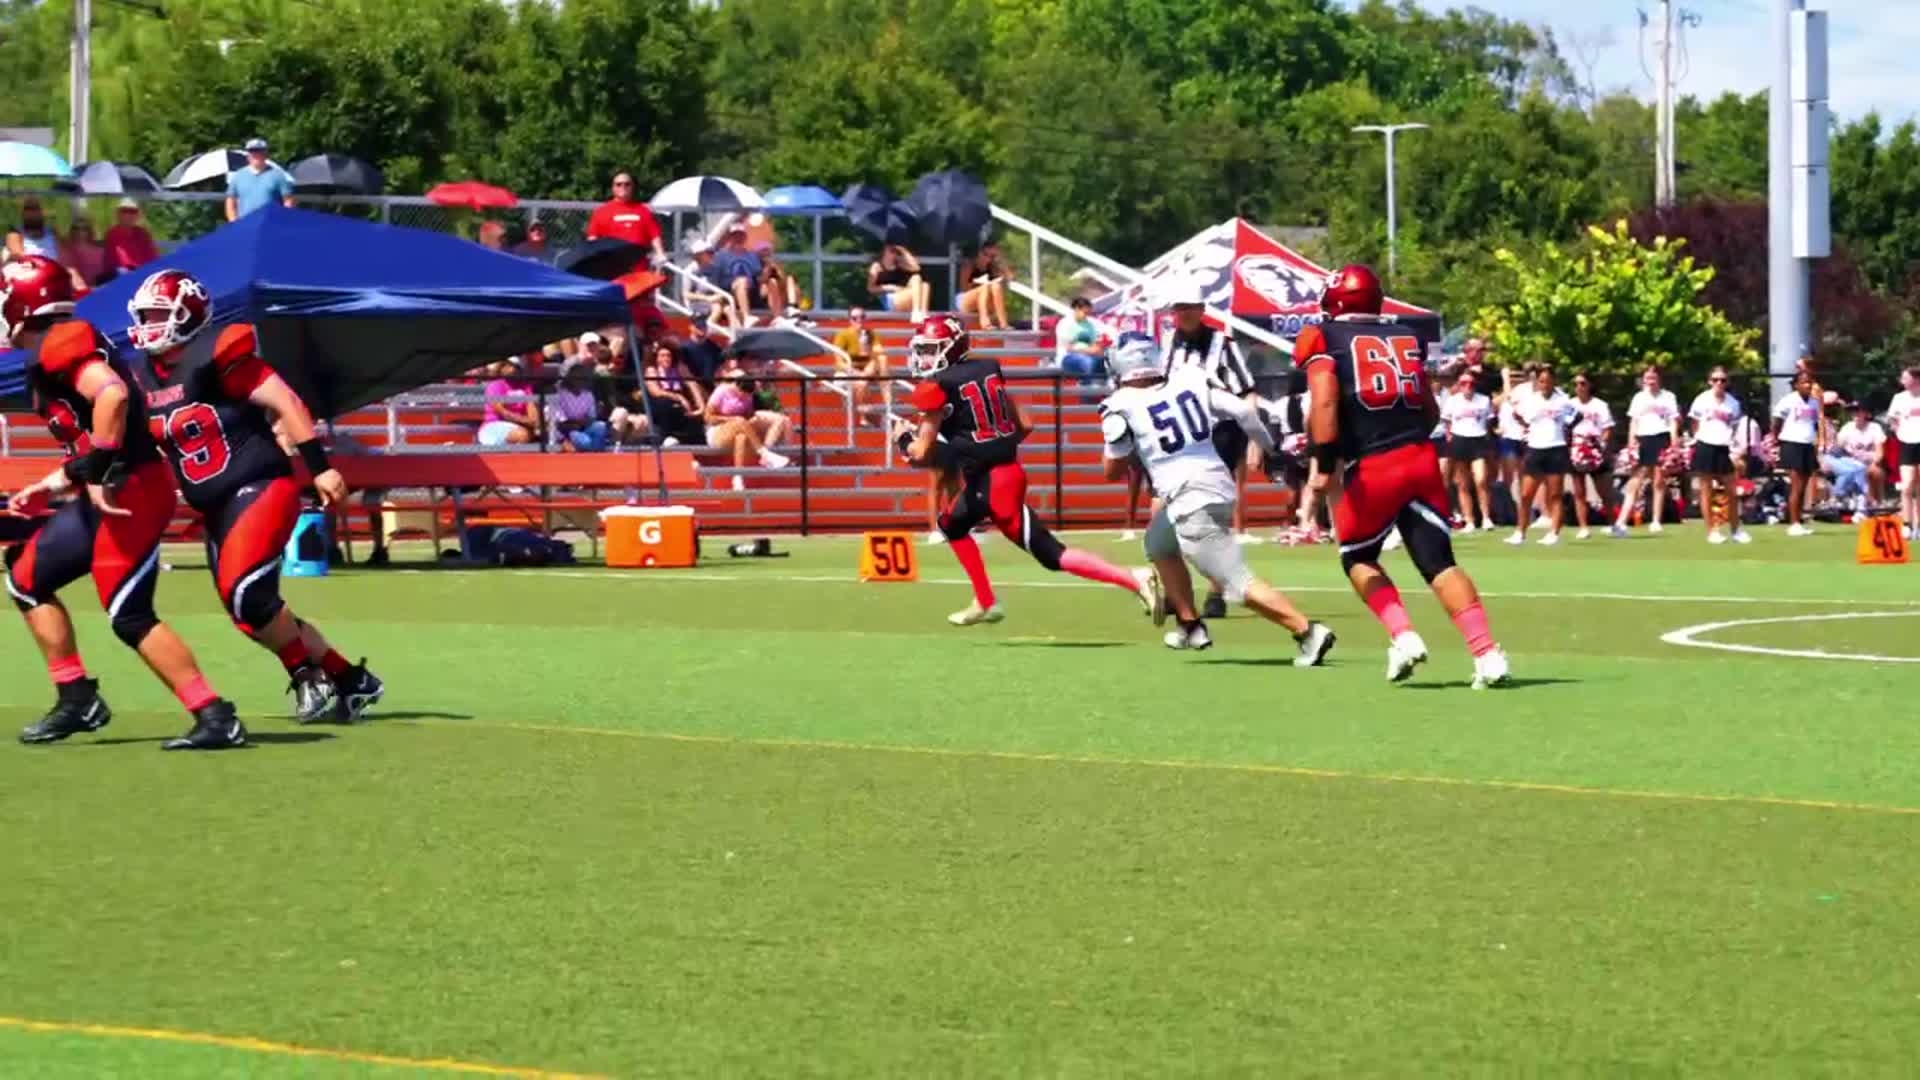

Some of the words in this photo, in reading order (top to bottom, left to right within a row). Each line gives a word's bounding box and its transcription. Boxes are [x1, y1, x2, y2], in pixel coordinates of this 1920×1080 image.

[1351, 335, 1425, 411] 65
[959, 373, 1016, 443] 10
[1147, 389, 1210, 455] 50
[639, 520, 661, 545] G
[871, 535, 911, 577] 50
[1873, 520, 1904, 559] 40
